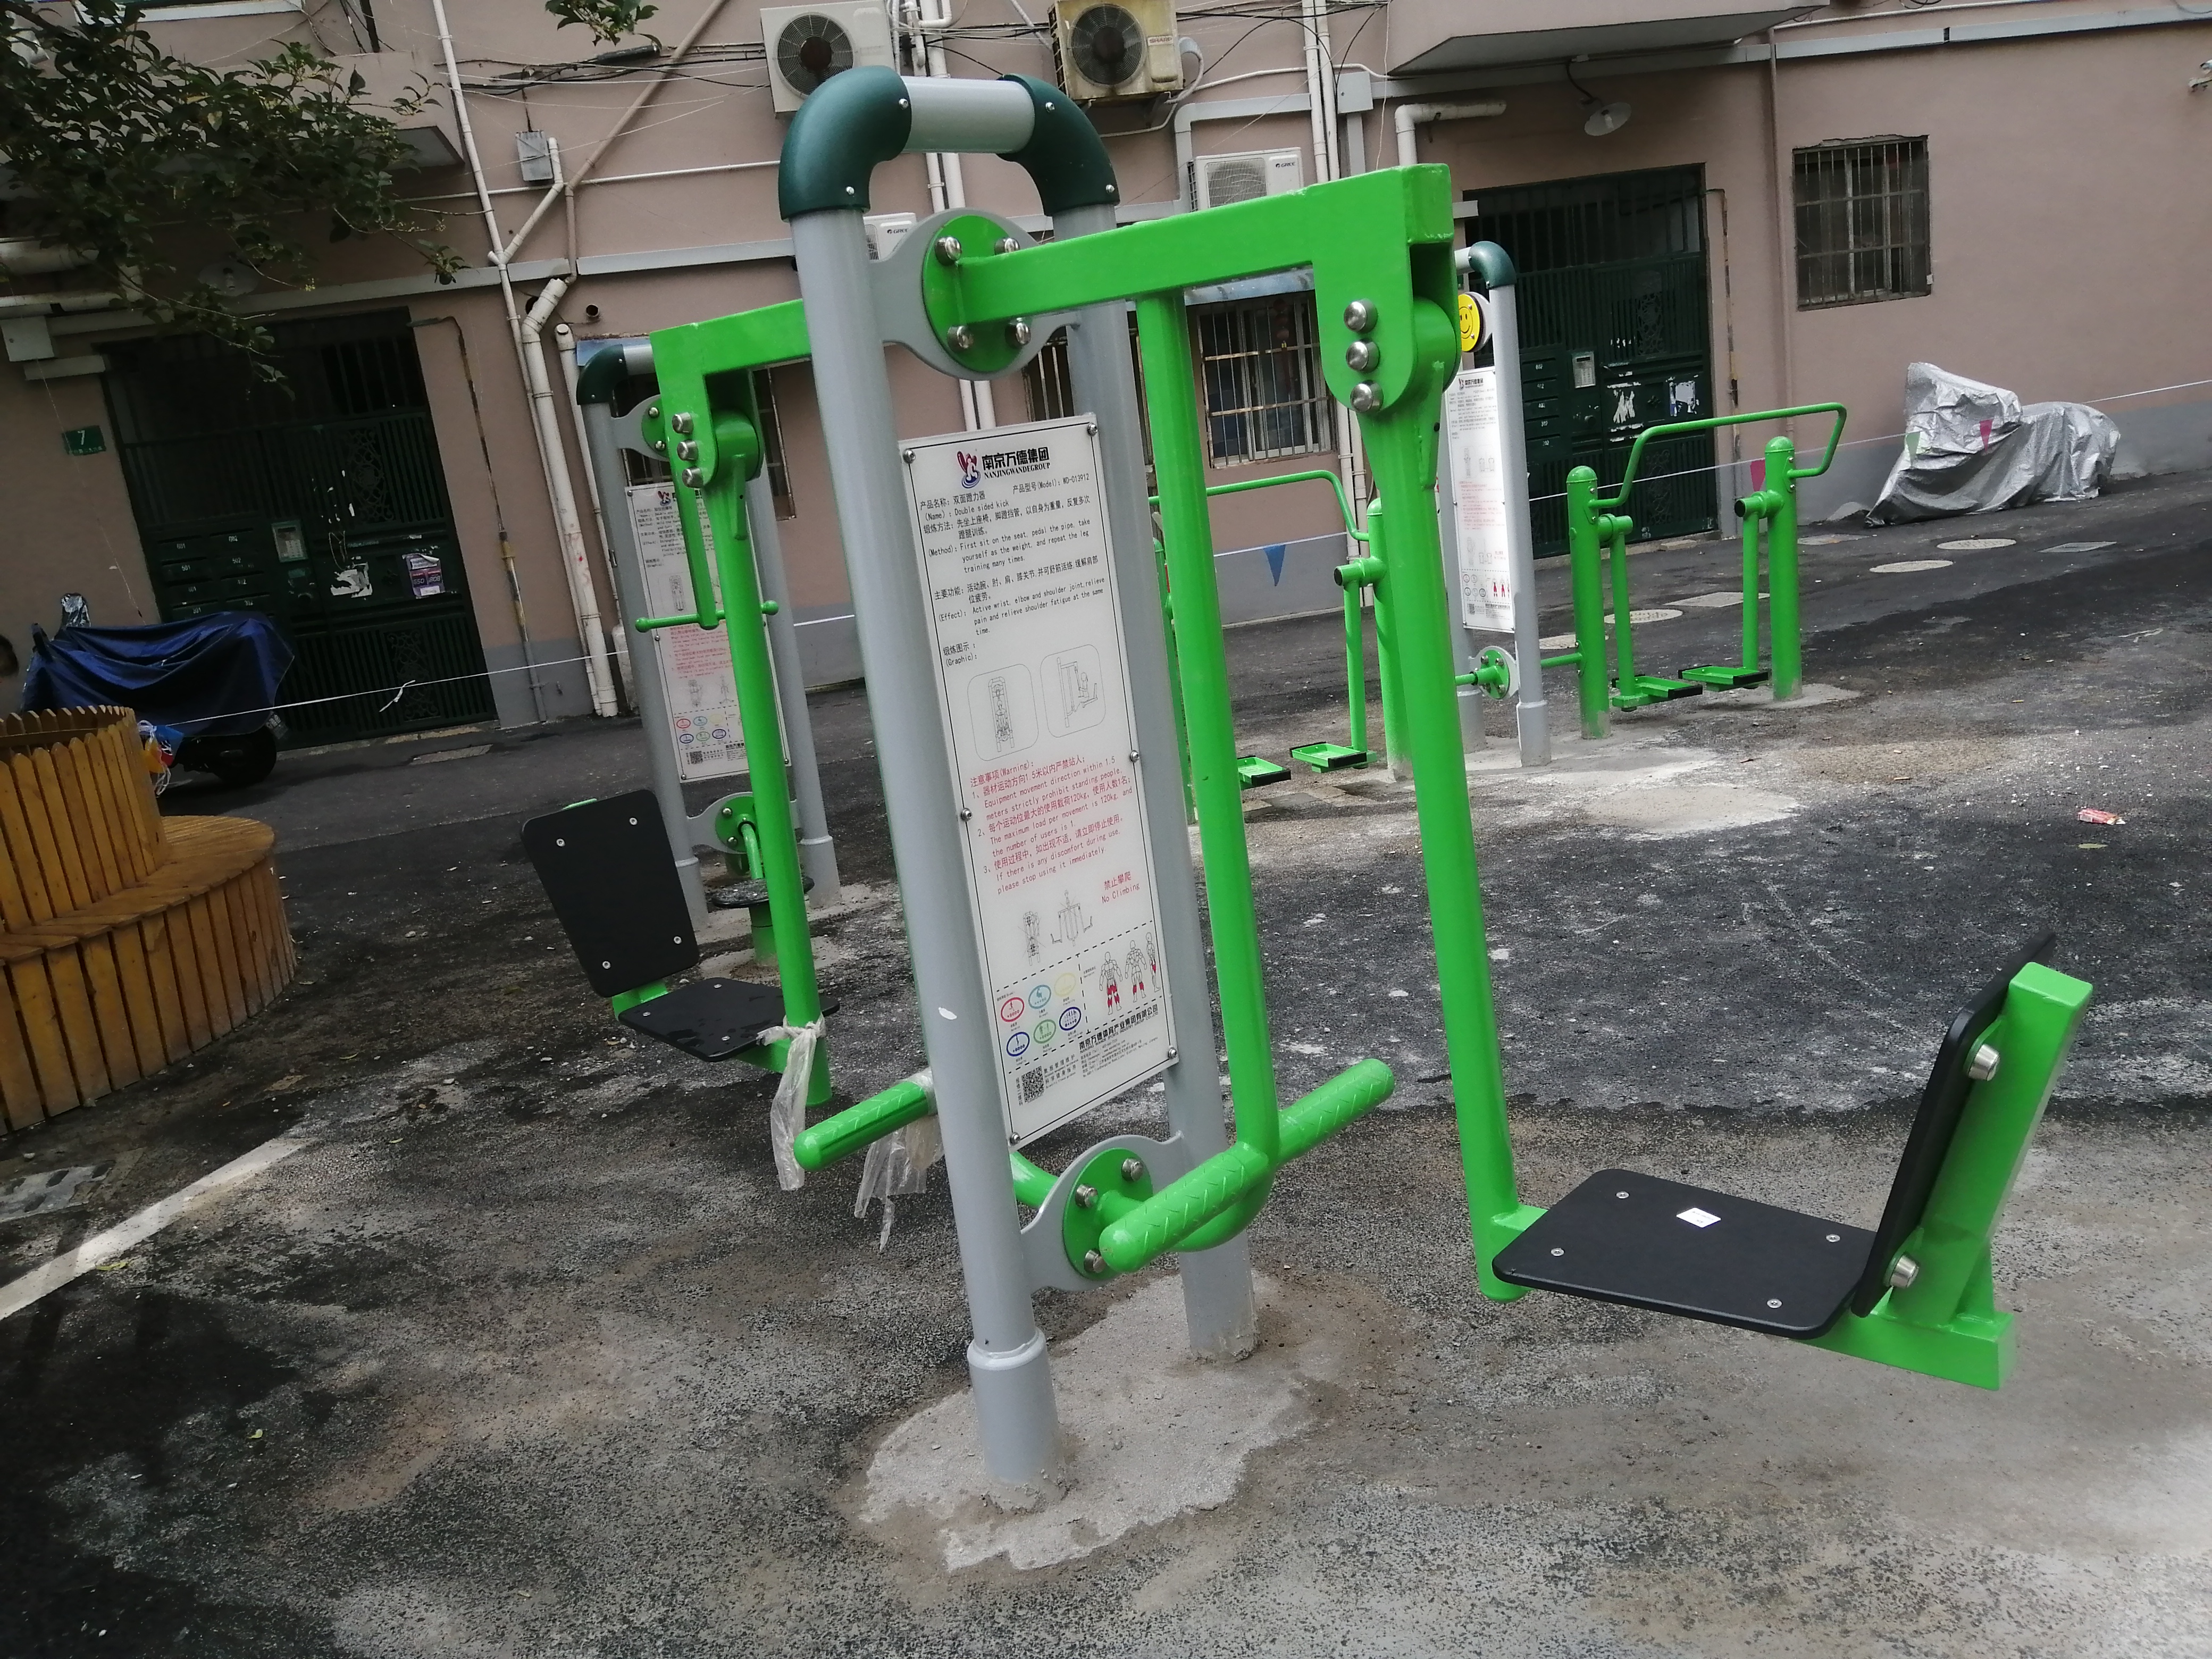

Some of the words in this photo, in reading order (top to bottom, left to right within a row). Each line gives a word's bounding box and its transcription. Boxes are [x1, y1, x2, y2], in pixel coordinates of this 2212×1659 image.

[77, 430, 85, 446] 7
[981, 446, 1050, 471] 南京万德集团
[982, 462, 1051, 480] NANJINGWANDEGROUP
[1062, 473, 1090, 484] WD-013912
[954, 505, 975, 516] Double
[977, 501, 994, 512] sided
[995, 499, 1009, 508] kick
[959, 540, 977, 551] First
[979, 538, 990, 547] sit
[1001, 534, 1011, 542] the
[1032, 526, 1047, 538] pedal
[1049, 524, 1059, 533] the
[1078, 518, 1091, 526] take
[962, 549, 988, 564] yourself
[1000, 546, 1010, 554] the
[1036, 537, 1046, 547] and
[1048, 534, 1067, 544] repeat
[963, 562, 990, 574] training
[1008, 556, 1025, 564] times.
[973, 604, 992, 614] Active
[1015, 595, 1030, 604] elbow
[1032, 591, 1042, 600] and
[1043, 586, 1066, 597] shoulder
[974, 615, 987, 626] pain
[989, 611, 999, 621] and
[1001, 608, 1023, 618] relieve
[1025, 601, 1048, 613] shoulder
[1051, 596, 1071, 606] fatigue
[984, 791, 1017, 808] Equipment
[1019, 780, 1048, 796] movement
[1050, 770, 1081, 785] direction
[1083, 761, 1103, 774] within
[986, 808, 1008, 821] meters
[1011, 796, 1039, 812] strictly
[1042, 785, 1069, 802] prohibit
[1072, 776, 1099, 790] standing
[990, 836, 1002, 845] The
[1004, 826, 1030, 840] maximum
[1033, 817, 1046, 830] load
[1048, 815, 1059, 825] per
[1061, 803, 1088, 818] movement
[1122, 785, 1133, 796] and
[992, 848, 1003, 858] the
[1006, 840, 1027, 852] number
[1030, 833, 1037, 843] of
[1040, 828, 1058, 839] users
[996, 872, 1003, 882] If
[1006, 866, 1024, 878] there
[1037, 857, 1048, 866] any
[1050, 842, 1084, 860] discomfort
[1086, 834, 1107, 846] during
[998, 881, 1019, 895] please
[1022, 874, 1036, 884] stop
[1038, 866, 1057, 877] using
[1101, 895, 1110, 904] No
[1112, 883, 1140, 899] Climbing
[1103, 871, 1132, 891] 禁止攀爬
